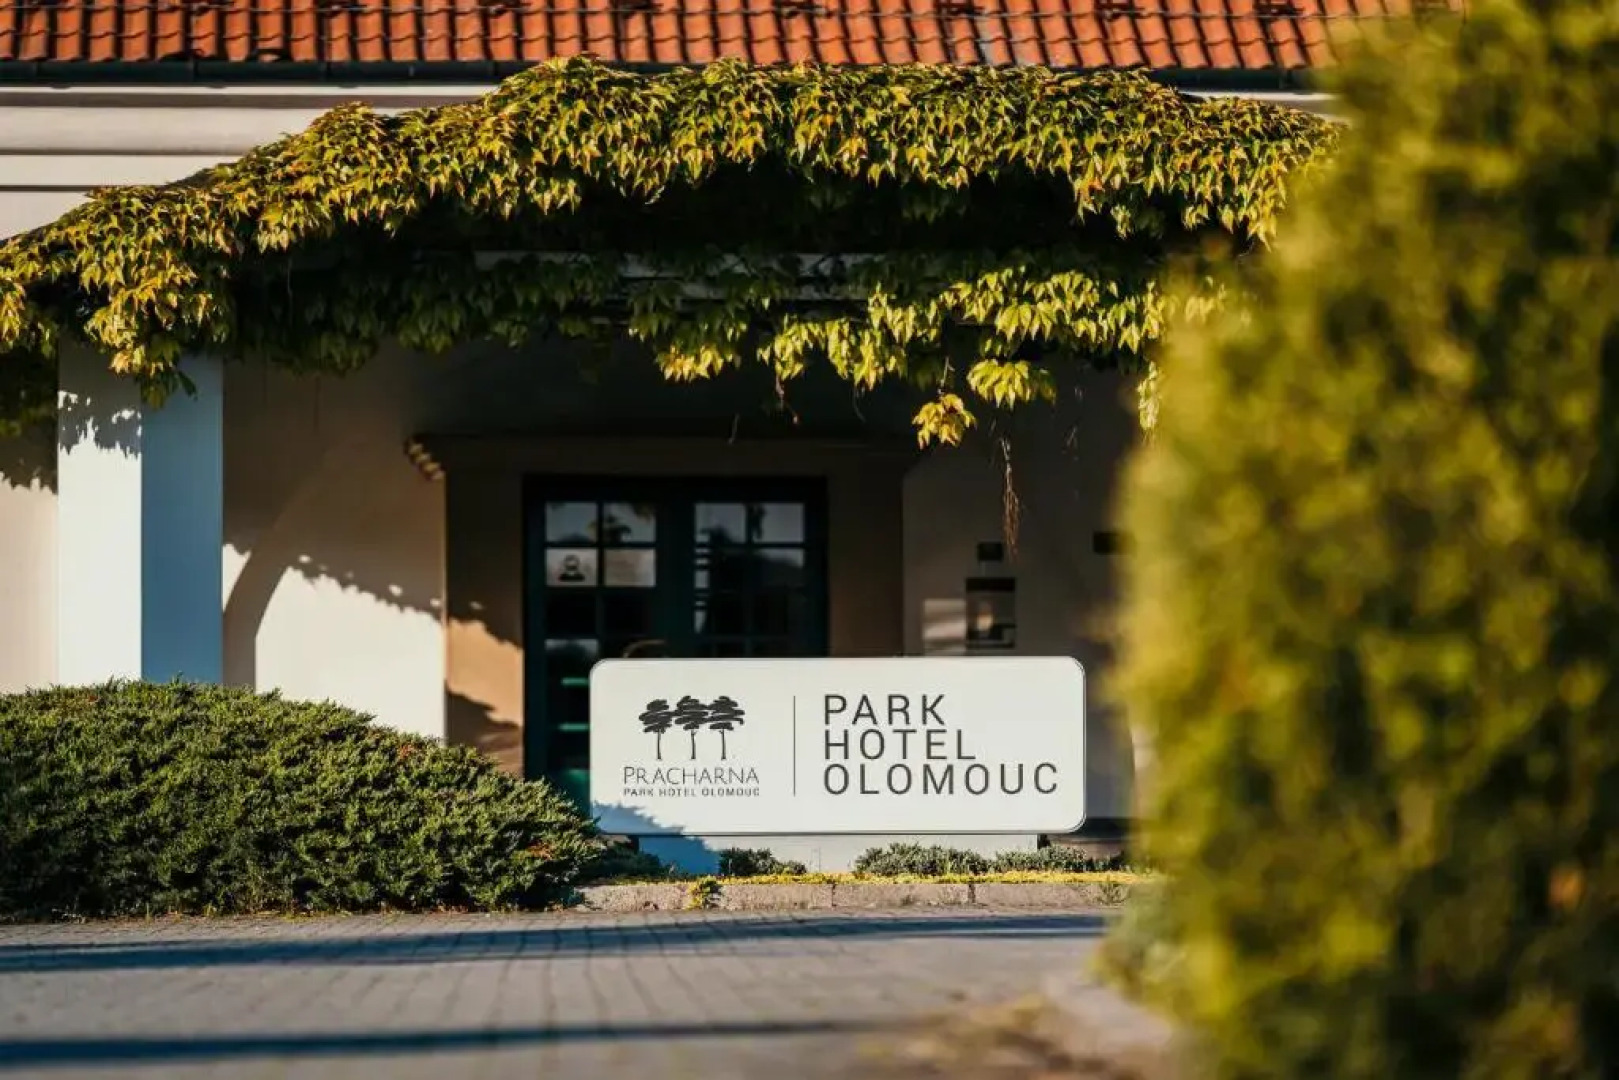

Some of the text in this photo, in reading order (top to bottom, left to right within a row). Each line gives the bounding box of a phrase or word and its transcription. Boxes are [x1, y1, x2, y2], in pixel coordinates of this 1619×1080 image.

[824, 694, 946, 725] PARK
[824, 729, 977, 760] HOTEL
[623, 766, 760, 785] PRACHARNA
[823, 763, 1059, 795] OLOMOUC
[623, 788, 760, 797] PARK HOTEL OLOMOUC
